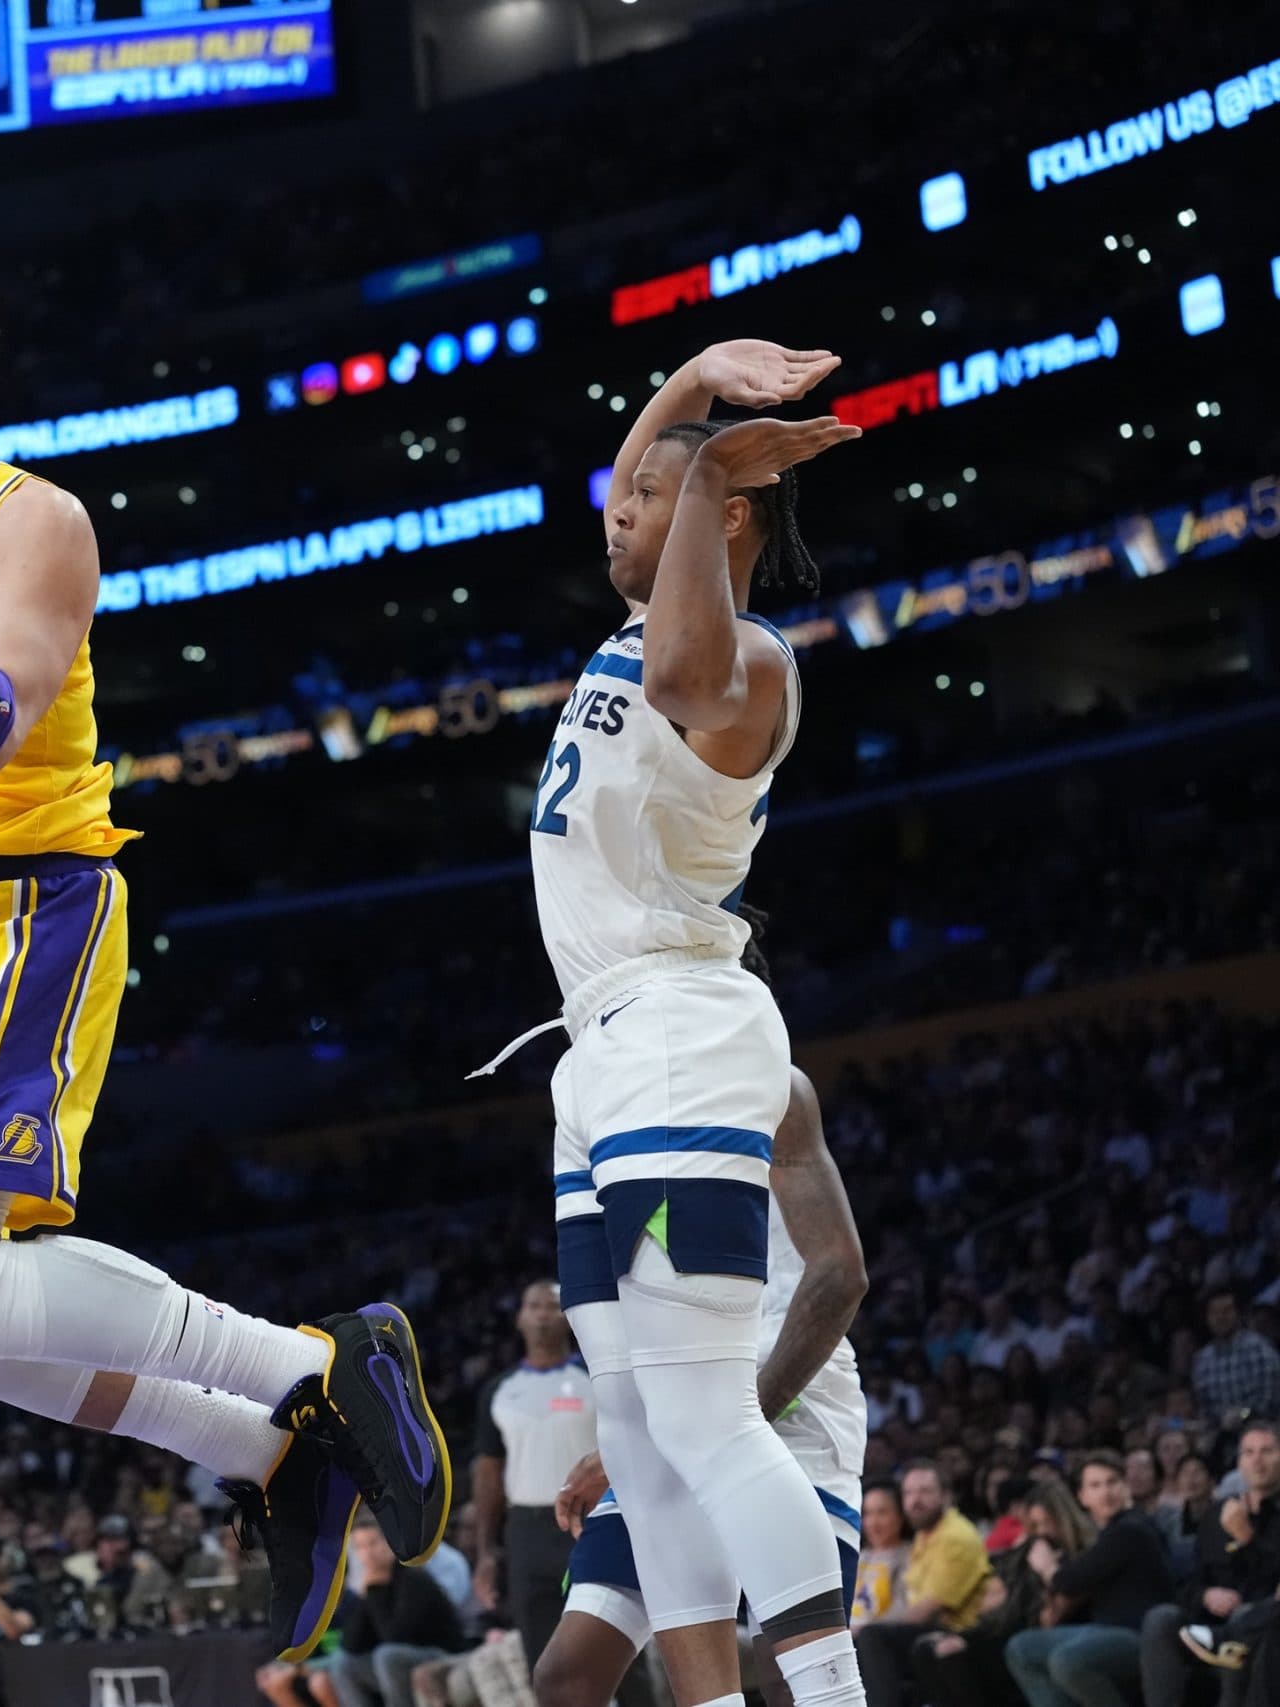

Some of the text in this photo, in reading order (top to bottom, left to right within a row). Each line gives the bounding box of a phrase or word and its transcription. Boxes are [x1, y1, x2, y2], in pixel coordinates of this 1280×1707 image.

[1028, 107, 1164, 192] FOLLOW
[1164, 89, 1214, 142] US
[140, 559, 202, 606] THE
[203, 541, 287, 594] ESPN
[329, 516, 395, 569] APP
[422, 483, 544, 547] LISTEN
